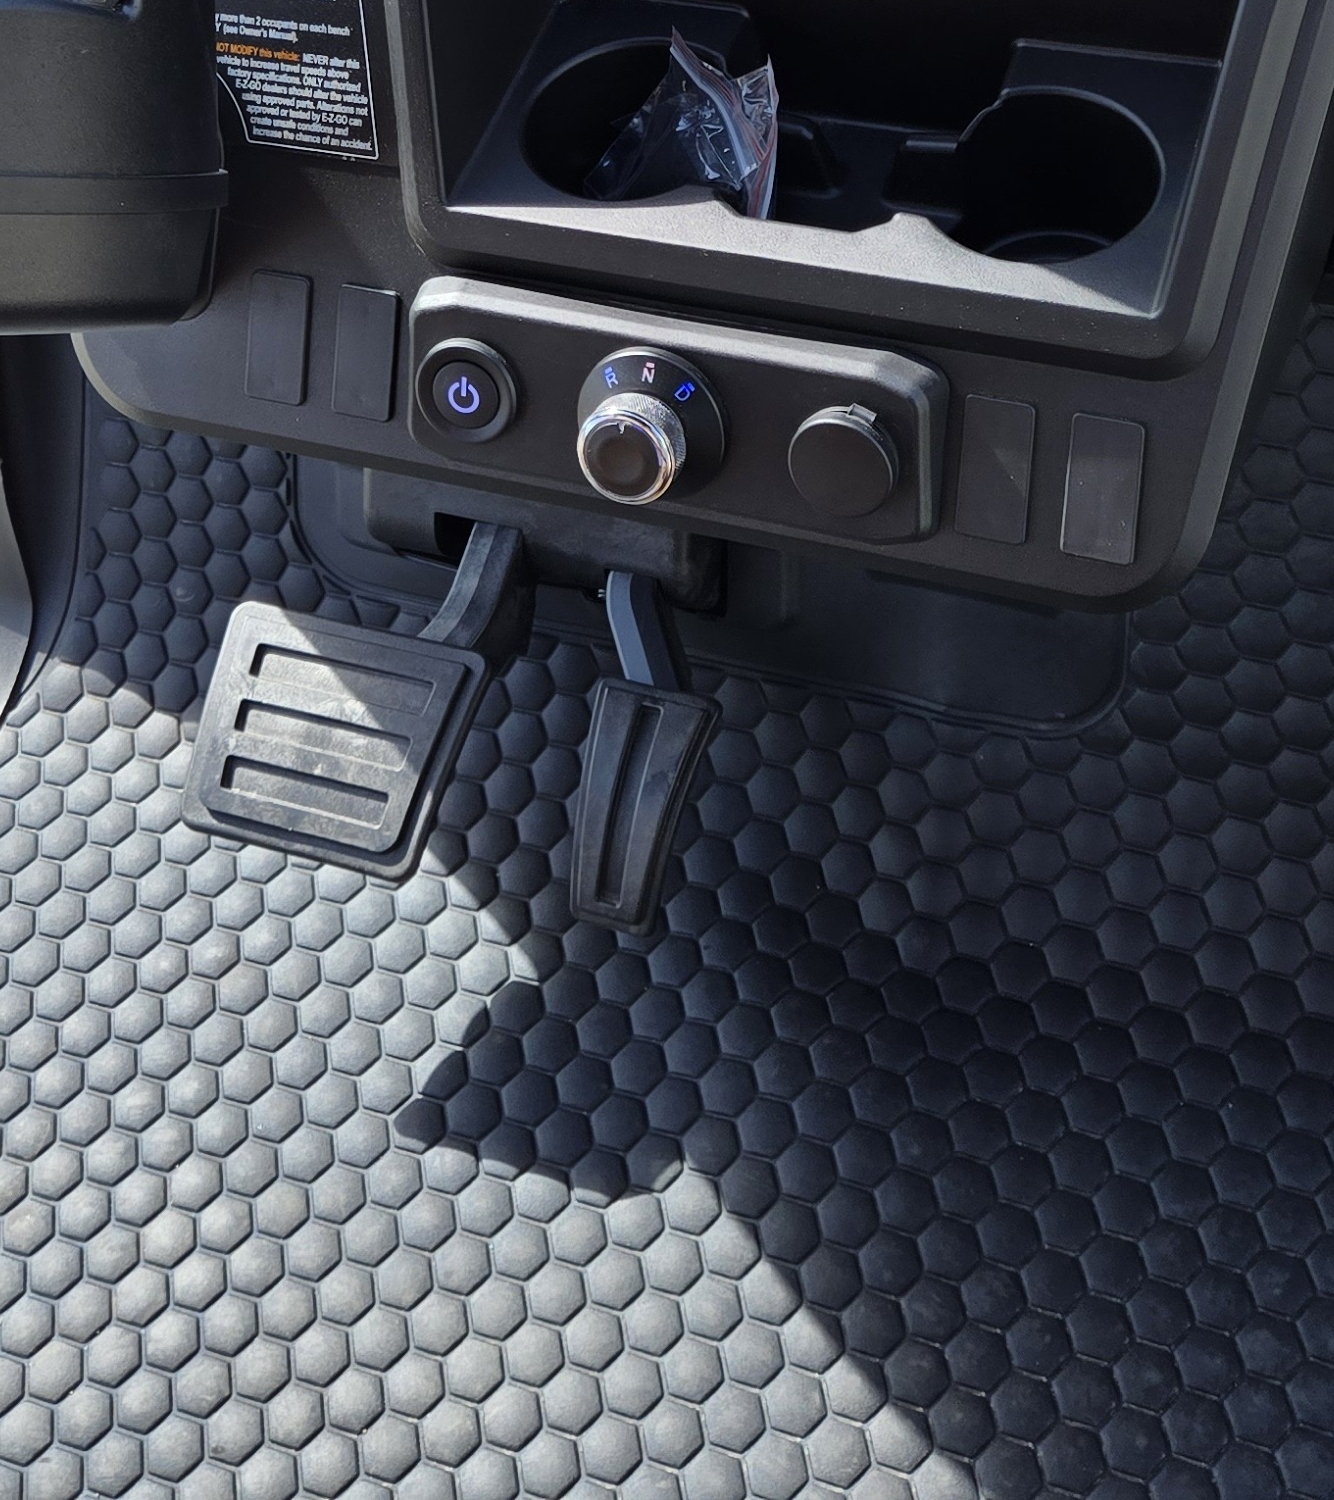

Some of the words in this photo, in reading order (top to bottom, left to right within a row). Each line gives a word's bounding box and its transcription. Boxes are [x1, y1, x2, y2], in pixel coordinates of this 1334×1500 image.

[230, 44, 259, 57] MODIFY
[259, 48, 273, 58] this
[302, 53, 329, 65] NEVER
[329, 56, 345, 68] alter
[345, 59, 360, 70] this
[605, 371, 618, 388] R
[641, 367, 655, 383] N
[674, 384, 691, 402] D
